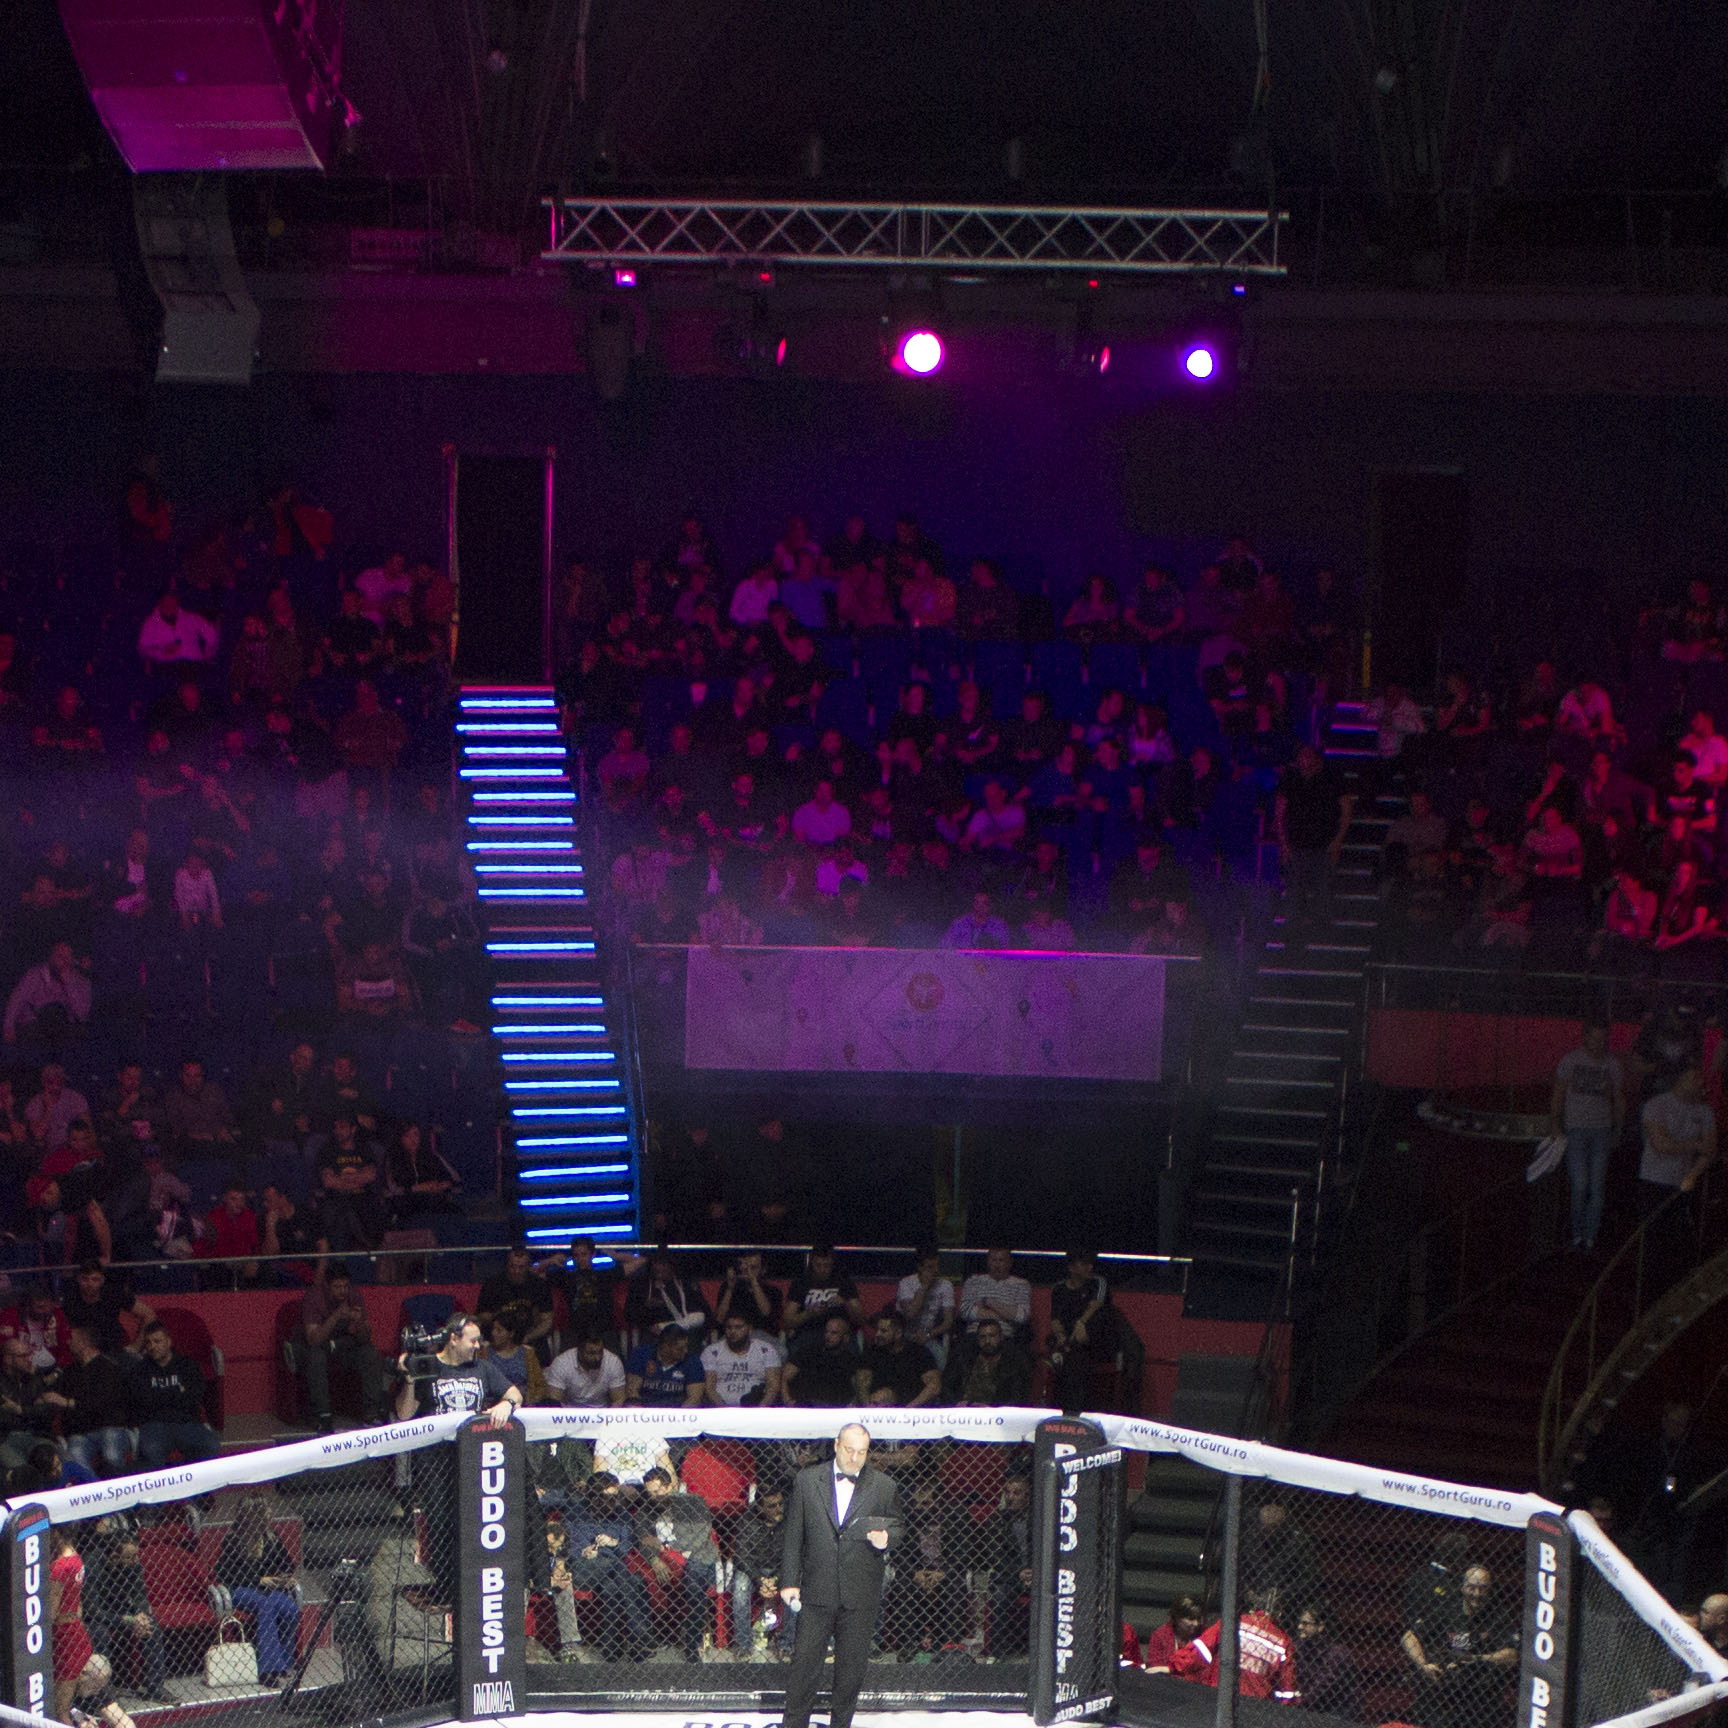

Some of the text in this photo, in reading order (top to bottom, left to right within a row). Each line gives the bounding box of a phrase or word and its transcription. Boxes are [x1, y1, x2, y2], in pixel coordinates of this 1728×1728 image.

[552, 1412, 698, 1427] www.SportGuru.ro
[322, 1422, 436, 1455] www.SportGuru.ro
[1129, 1422, 1249, 1461] www.SportGuru.ro
[1061, 1448, 1122, 1475] WELCOME!
[68, 1470, 194, 1508] www.SportGuru.ro
[481, 1440, 506, 1550] BUDO
[1382, 1477, 1513, 1512] www.SportGuru.ro
[24, 1534, 44, 1654] BUDO
[1534, 1541, 1557, 1661] BUDO
[481, 1566, 506, 1674] BEST
[473, 1680, 515, 1715] MMA
[1084, 1696, 1113, 1714] BEST
